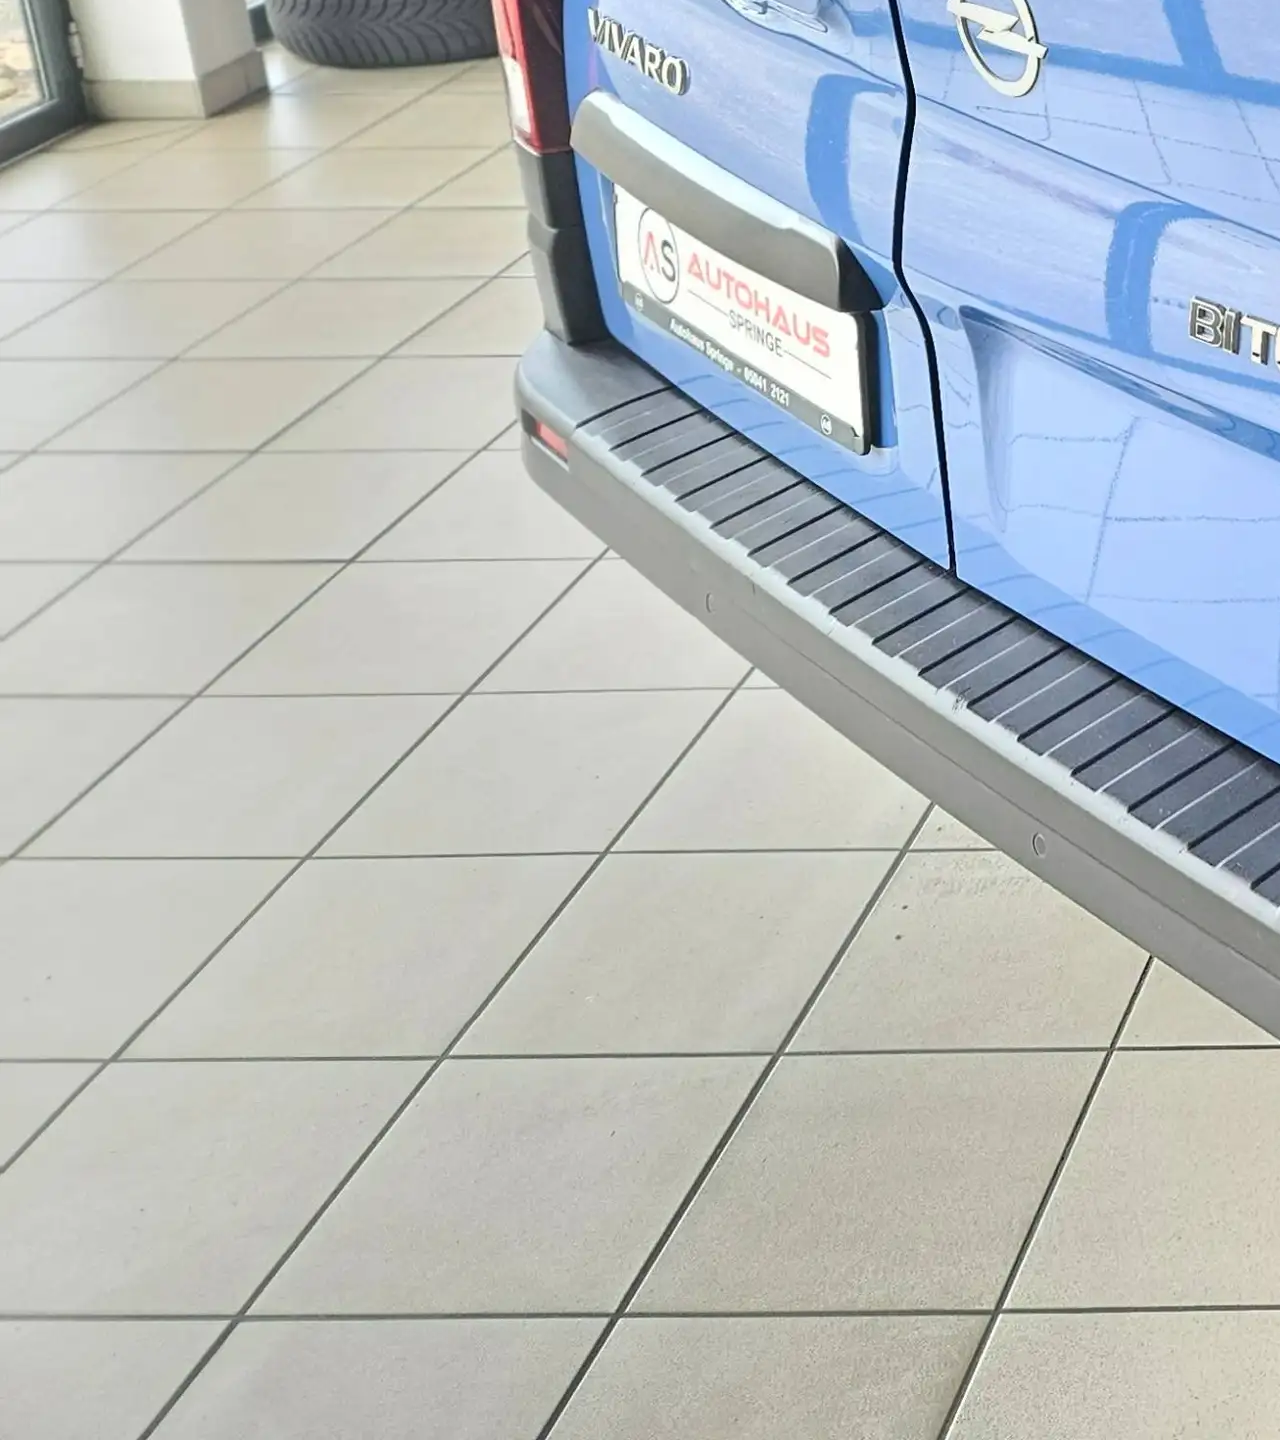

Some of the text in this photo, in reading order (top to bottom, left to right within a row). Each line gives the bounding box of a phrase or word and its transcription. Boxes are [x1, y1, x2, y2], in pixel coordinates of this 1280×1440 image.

[587, 7, 690, 95] VIVARO
[686, 252, 832, 359] AUTOHAUS
[728, 310, 784, 358] SPRINGE
[669, 317, 705, 353] Autohaus
[705, 340, 735, 373] Springe
[743, 366, 768, 393] 05041
[770, 383, 790, 407] 2121
